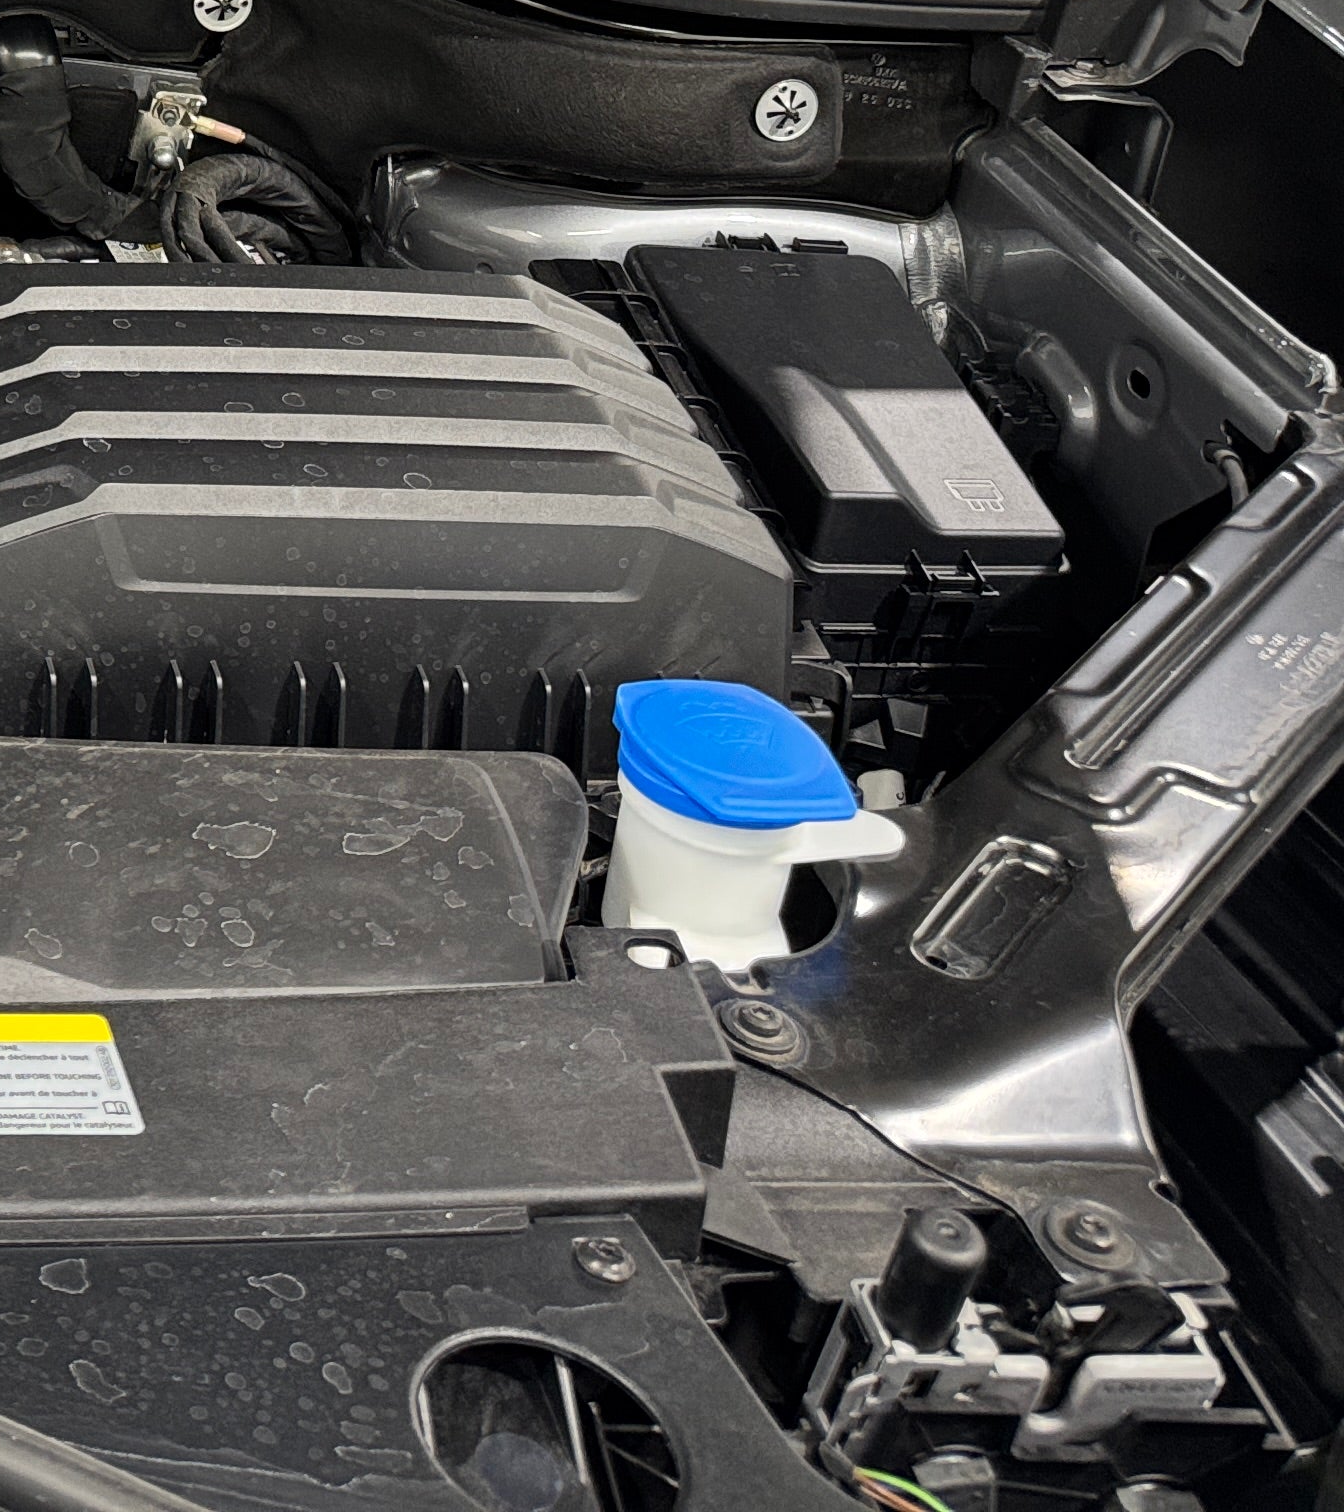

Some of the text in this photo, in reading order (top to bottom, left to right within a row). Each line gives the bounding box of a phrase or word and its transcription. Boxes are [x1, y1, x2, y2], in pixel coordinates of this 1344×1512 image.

[54, 1073, 102, 1081] TOUCHING
[8, 1090, 35, 1098] avant
[38, 1090, 50, 1098] de
[52, 1090, 88, 1098] toucher
[50, 1122, 71, 1130] pour
